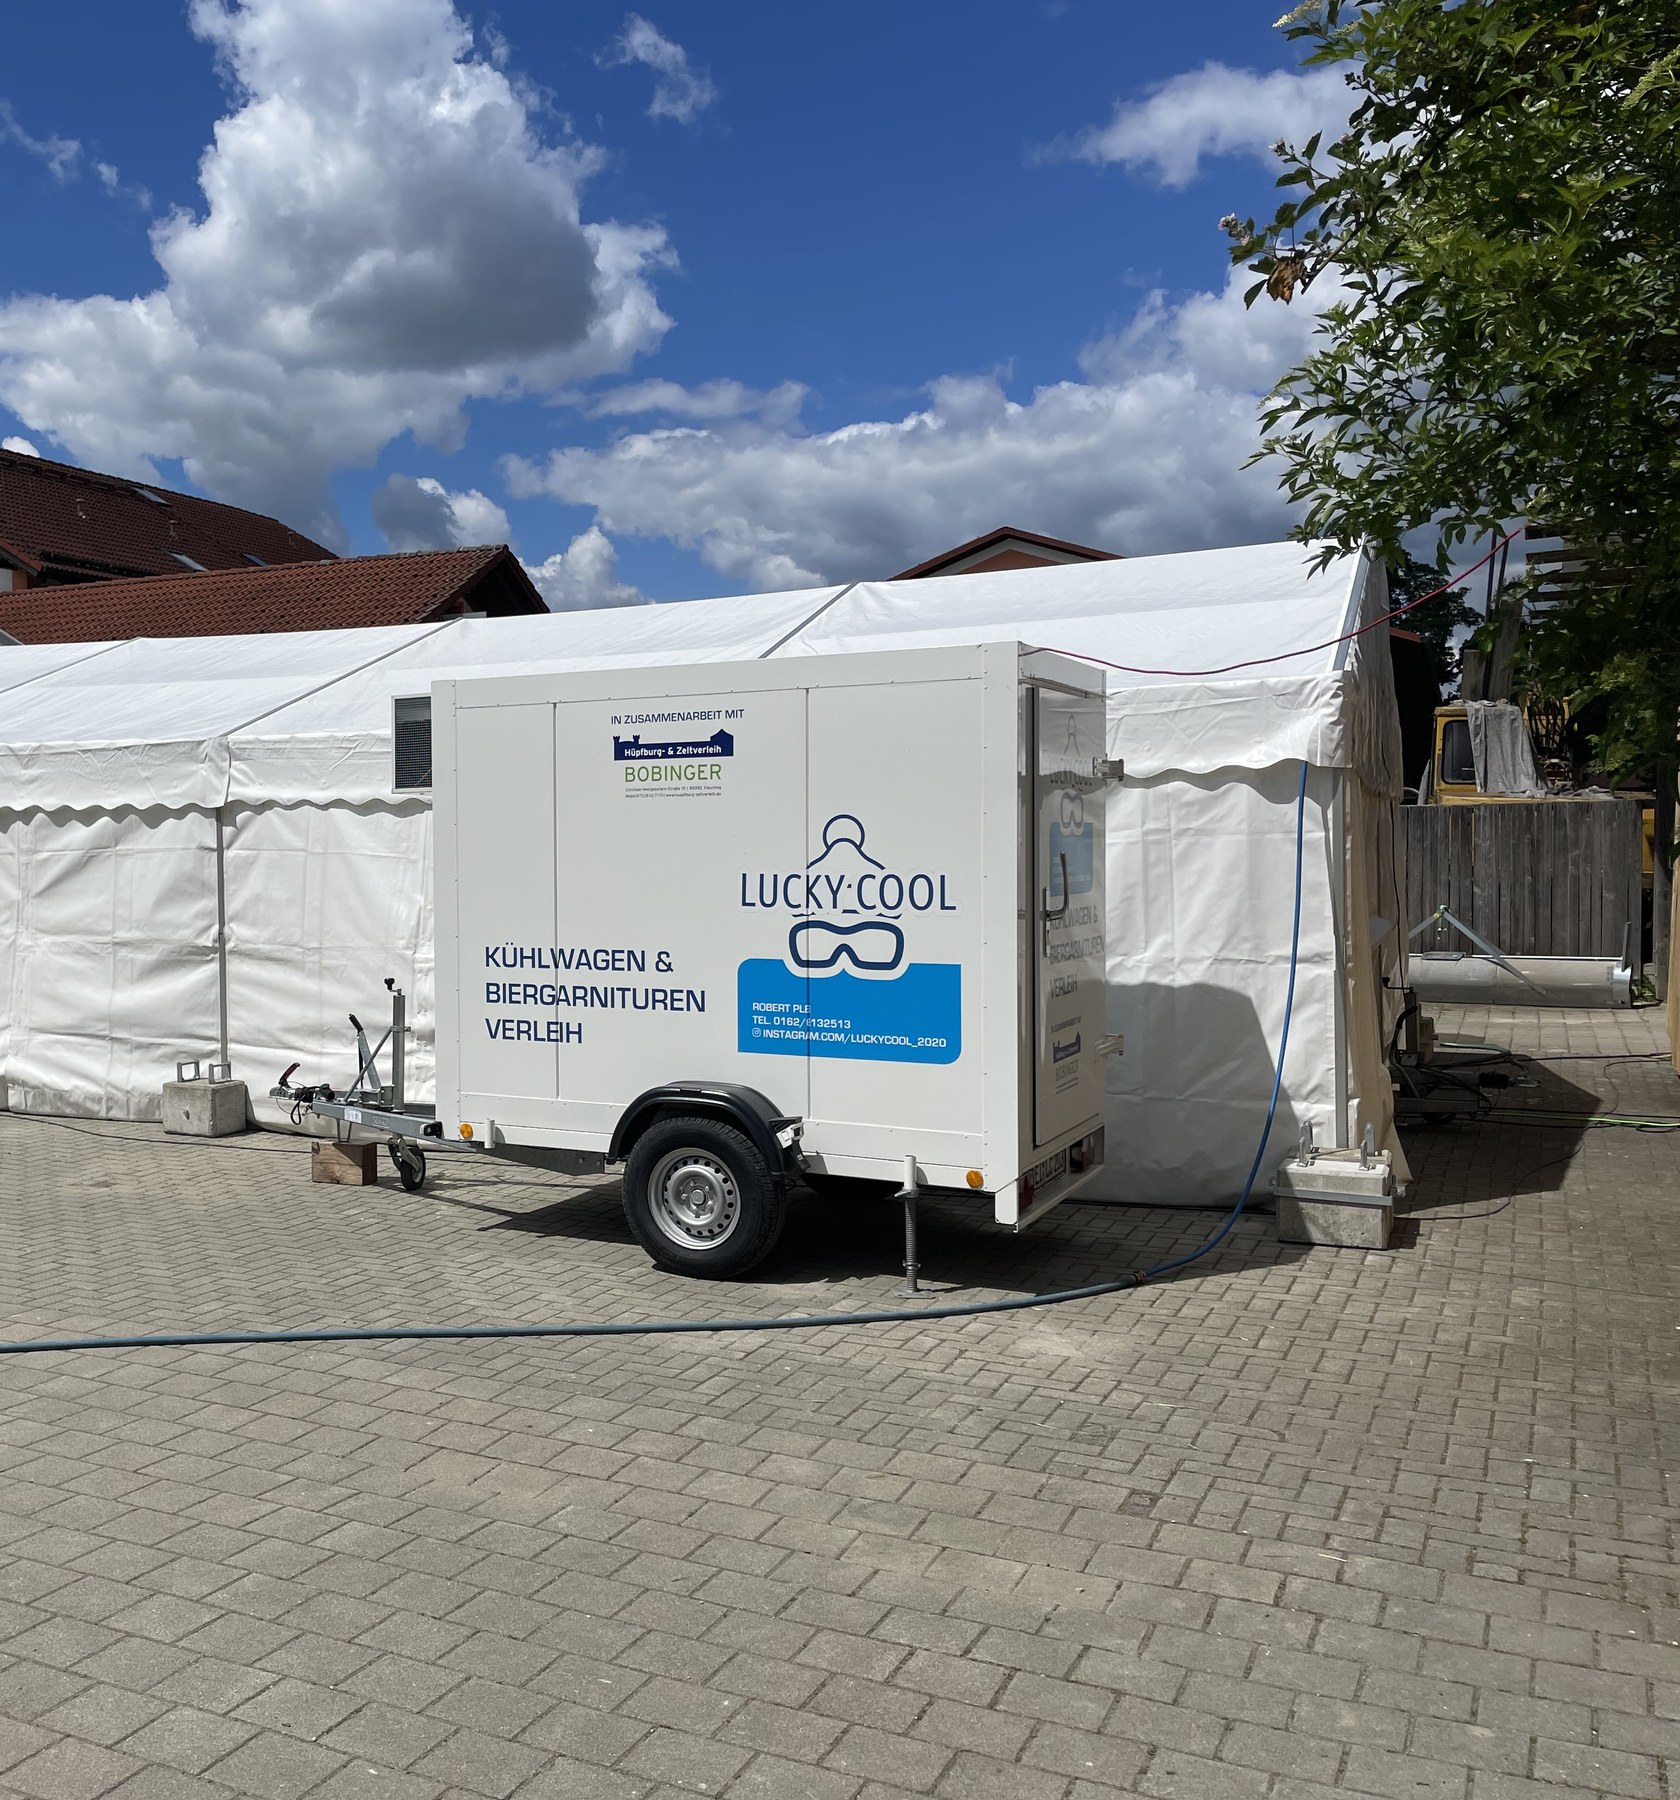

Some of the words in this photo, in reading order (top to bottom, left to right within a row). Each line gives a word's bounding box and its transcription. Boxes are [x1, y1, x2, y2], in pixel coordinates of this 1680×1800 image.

[611, 715, 622, 725] IN
[624, 711, 722, 724] ZUSAMMENARBEIT
[725, 709, 745, 719] MIT
[624, 747, 666, 758] Hüpfburg-
[667, 746, 674, 755] &
[676, 744, 722, 756] Zeltverleih
[625, 764, 722, 782] BOBINGER
[741, 872, 845, 909] LUCKY
[857, 873, 957, 911] COOL
[485, 942, 646, 972] KÜHLWAGEN
[655, 951, 674, 973] &
[485, 982, 706, 1012] BIERGARNITUREN
[752, 1003, 791, 1013] ROBERT
[485, 1018, 583, 1044] VERLEIH
[763, 1030, 947, 1048] INSTAGRAM.COM/LUCKYCOOL_2020
